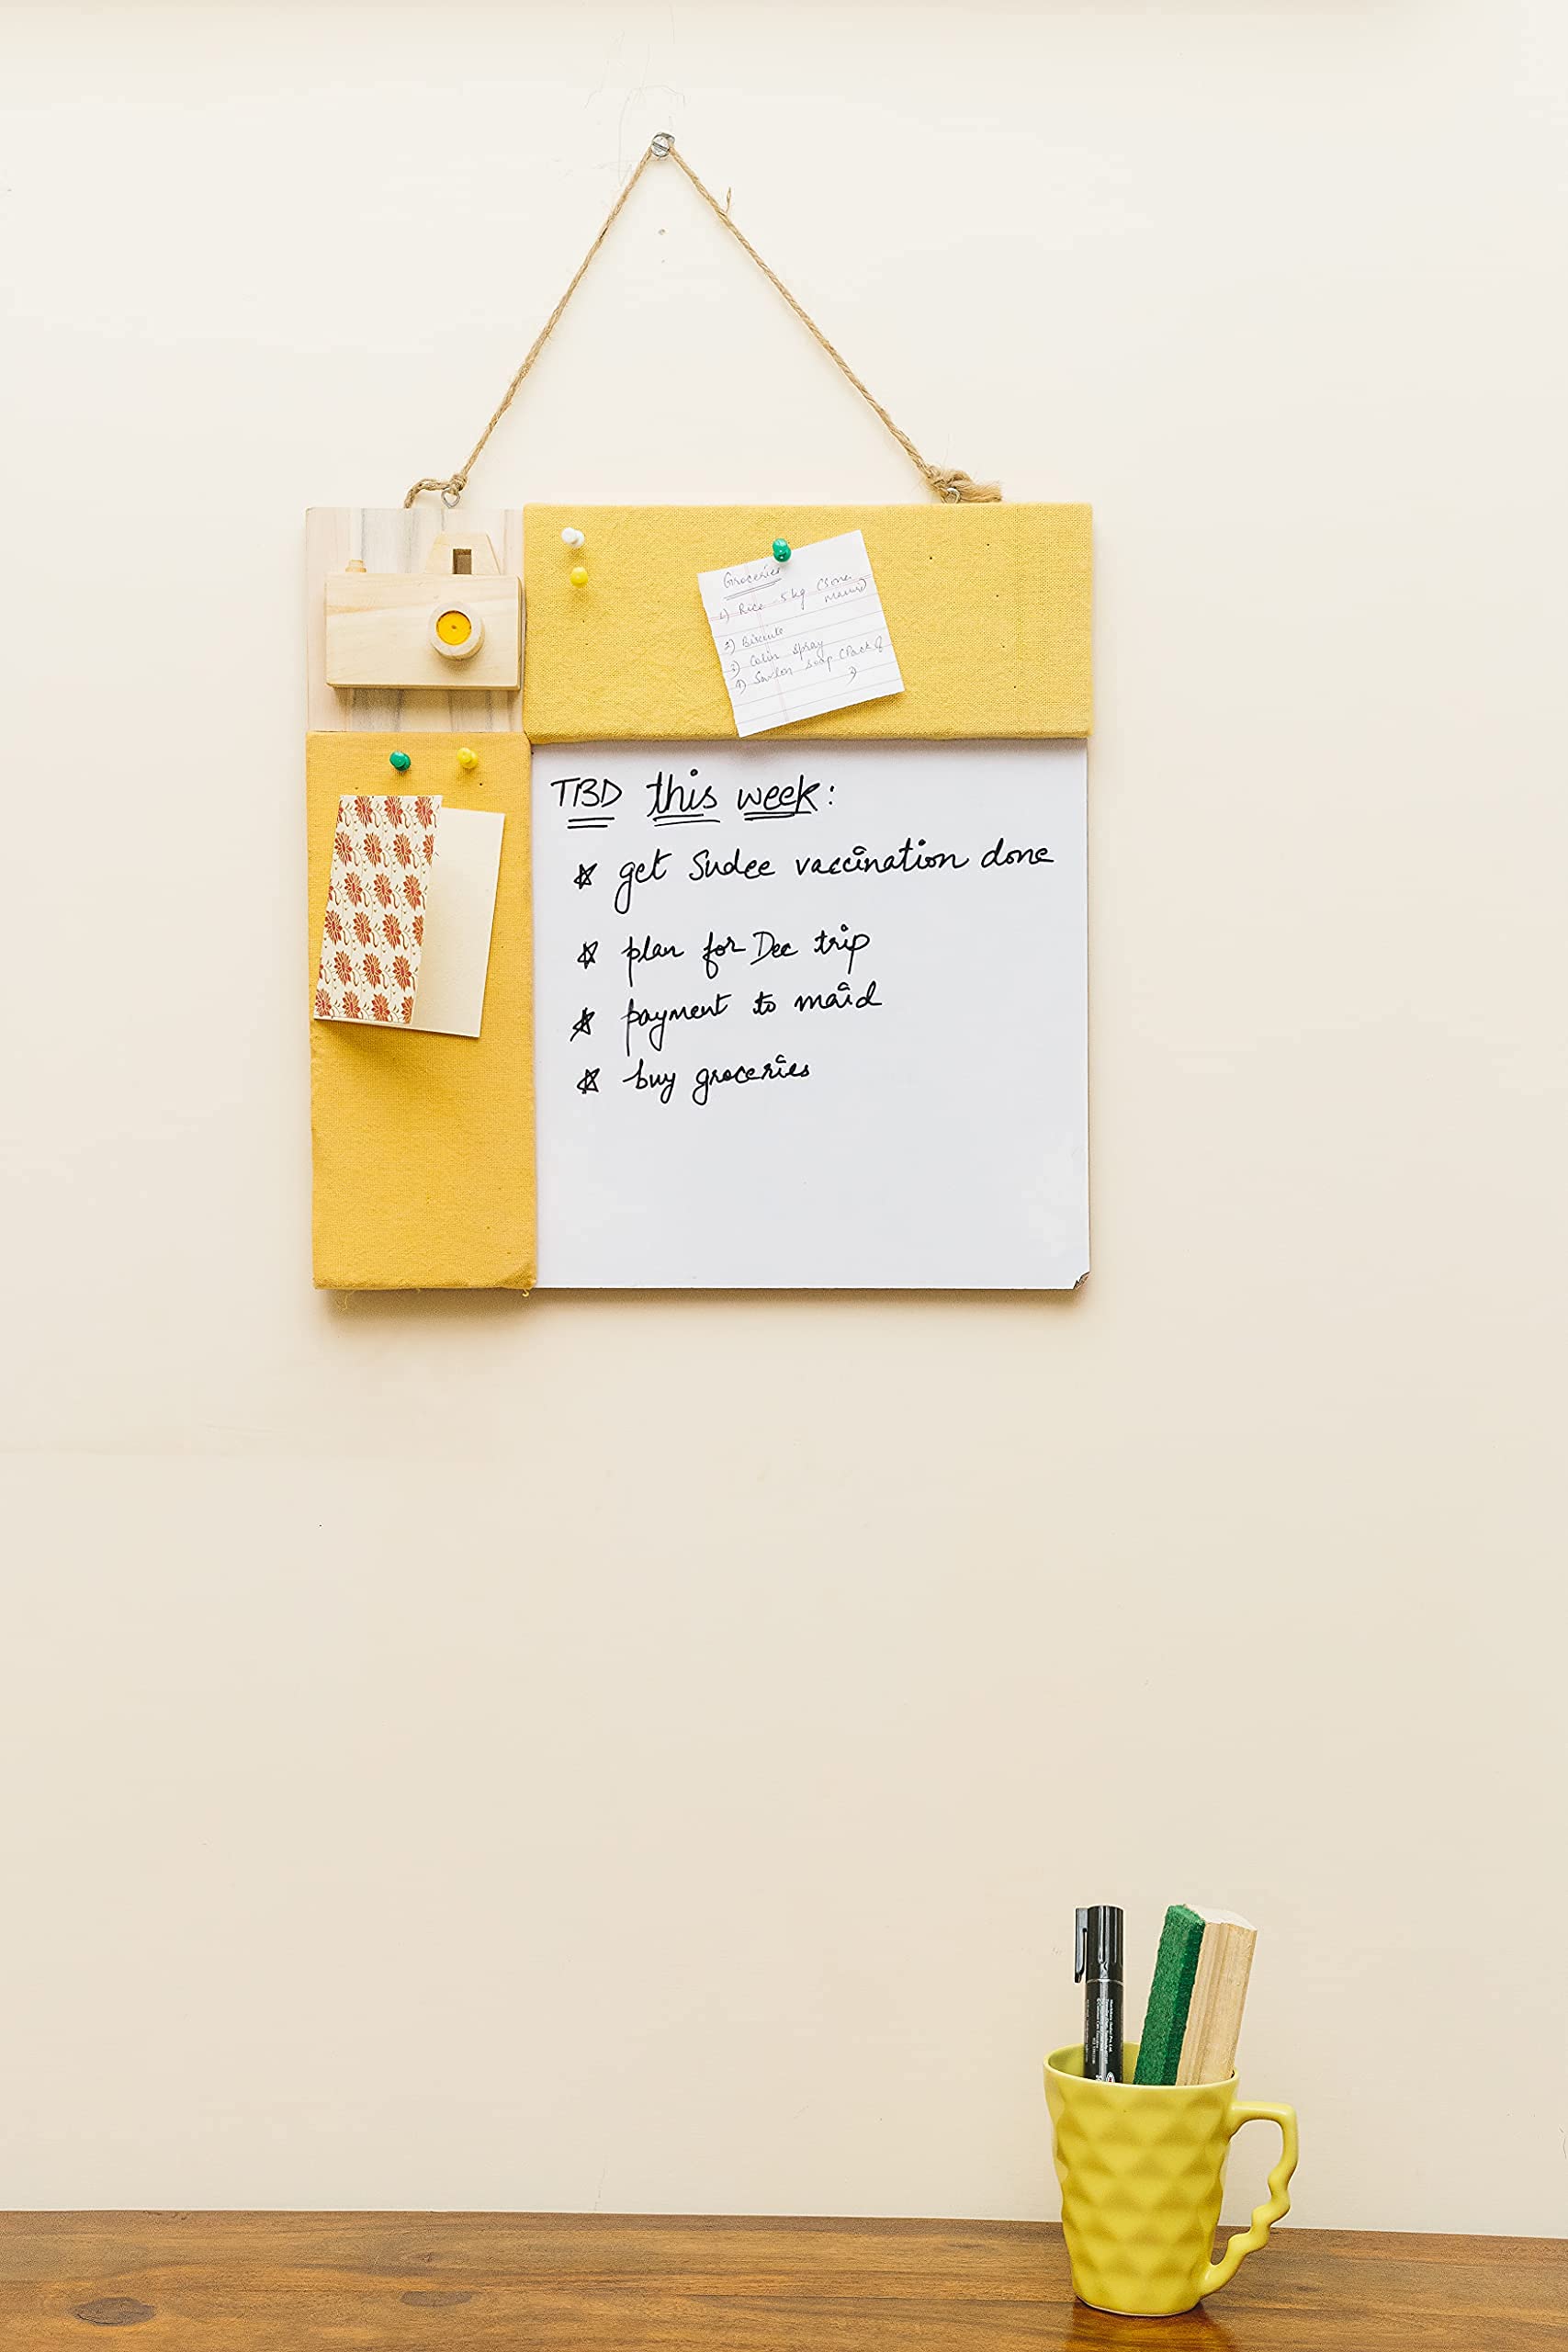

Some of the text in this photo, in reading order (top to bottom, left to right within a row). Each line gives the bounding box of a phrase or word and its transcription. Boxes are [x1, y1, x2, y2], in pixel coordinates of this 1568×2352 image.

[739, 602, 764, 615] Rice
[550, 777, 623, 808] TBD
[646, 768, 718, 819] this
[614, 848, 672, 915] get
[795, 837, 970, 876] vaccination
[980, 837, 1055, 868] done
[621, 935, 685, 988] plan
[702, 931, 747, 980] for
[814, 923, 871, 975] trip
[626, 980, 883, 1057] payment to maid
[622, 1054, 810, 1106] buy groceries
